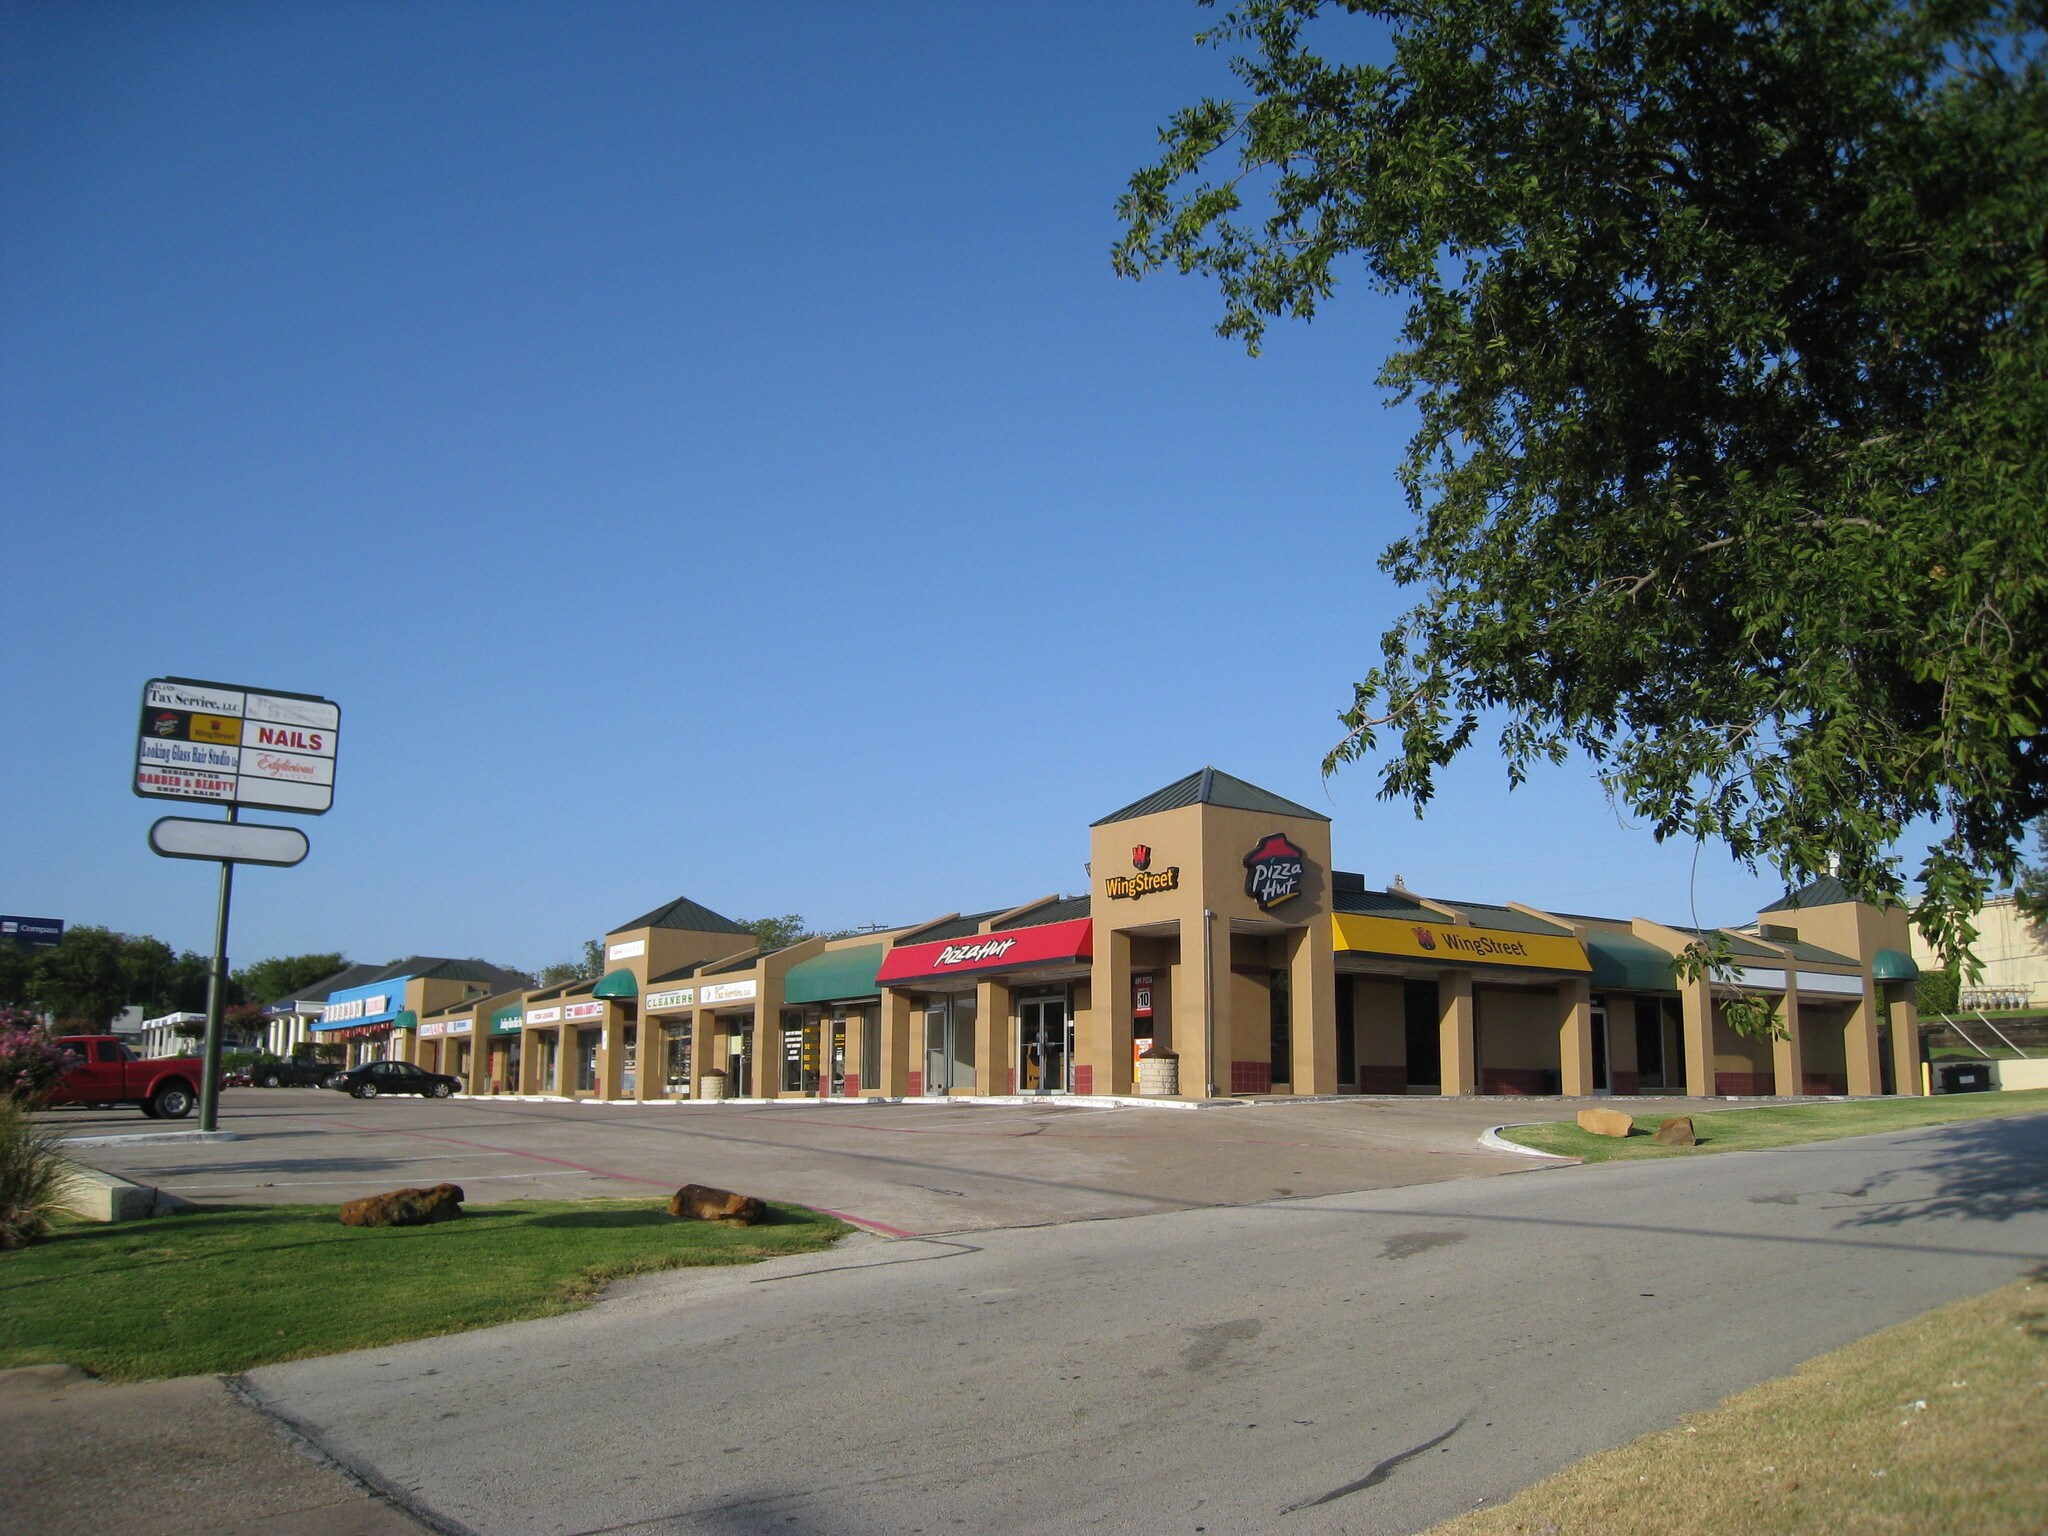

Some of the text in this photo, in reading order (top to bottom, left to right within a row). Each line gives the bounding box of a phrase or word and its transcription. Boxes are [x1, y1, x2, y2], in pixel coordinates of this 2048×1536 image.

[150, 690, 171, 704] Tax
[195, 729, 235, 741] WingStreet
[259, 727, 322, 751] NAILS
[142, 741, 170, 763] Looking
[172, 745, 190, 762] Glass
[192, 747, 207, 763] Hair
[208, 749, 230, 766] Studio
[256, 752, 316, 777] Edylicious
[138, 772, 235, 792] BARBER & BEAUTY
[161, 768, 219, 780] DESIGN PLUS
[1105, 869, 1175, 898] WingStreet
[1252, 857, 1303, 892] Pizza
[1263, 877, 1298, 901] Hut
[21, 924, 60, 934] Compass
[1441, 933, 1527, 956] WingStreet
[647, 993, 693, 1008] CLEANERS
